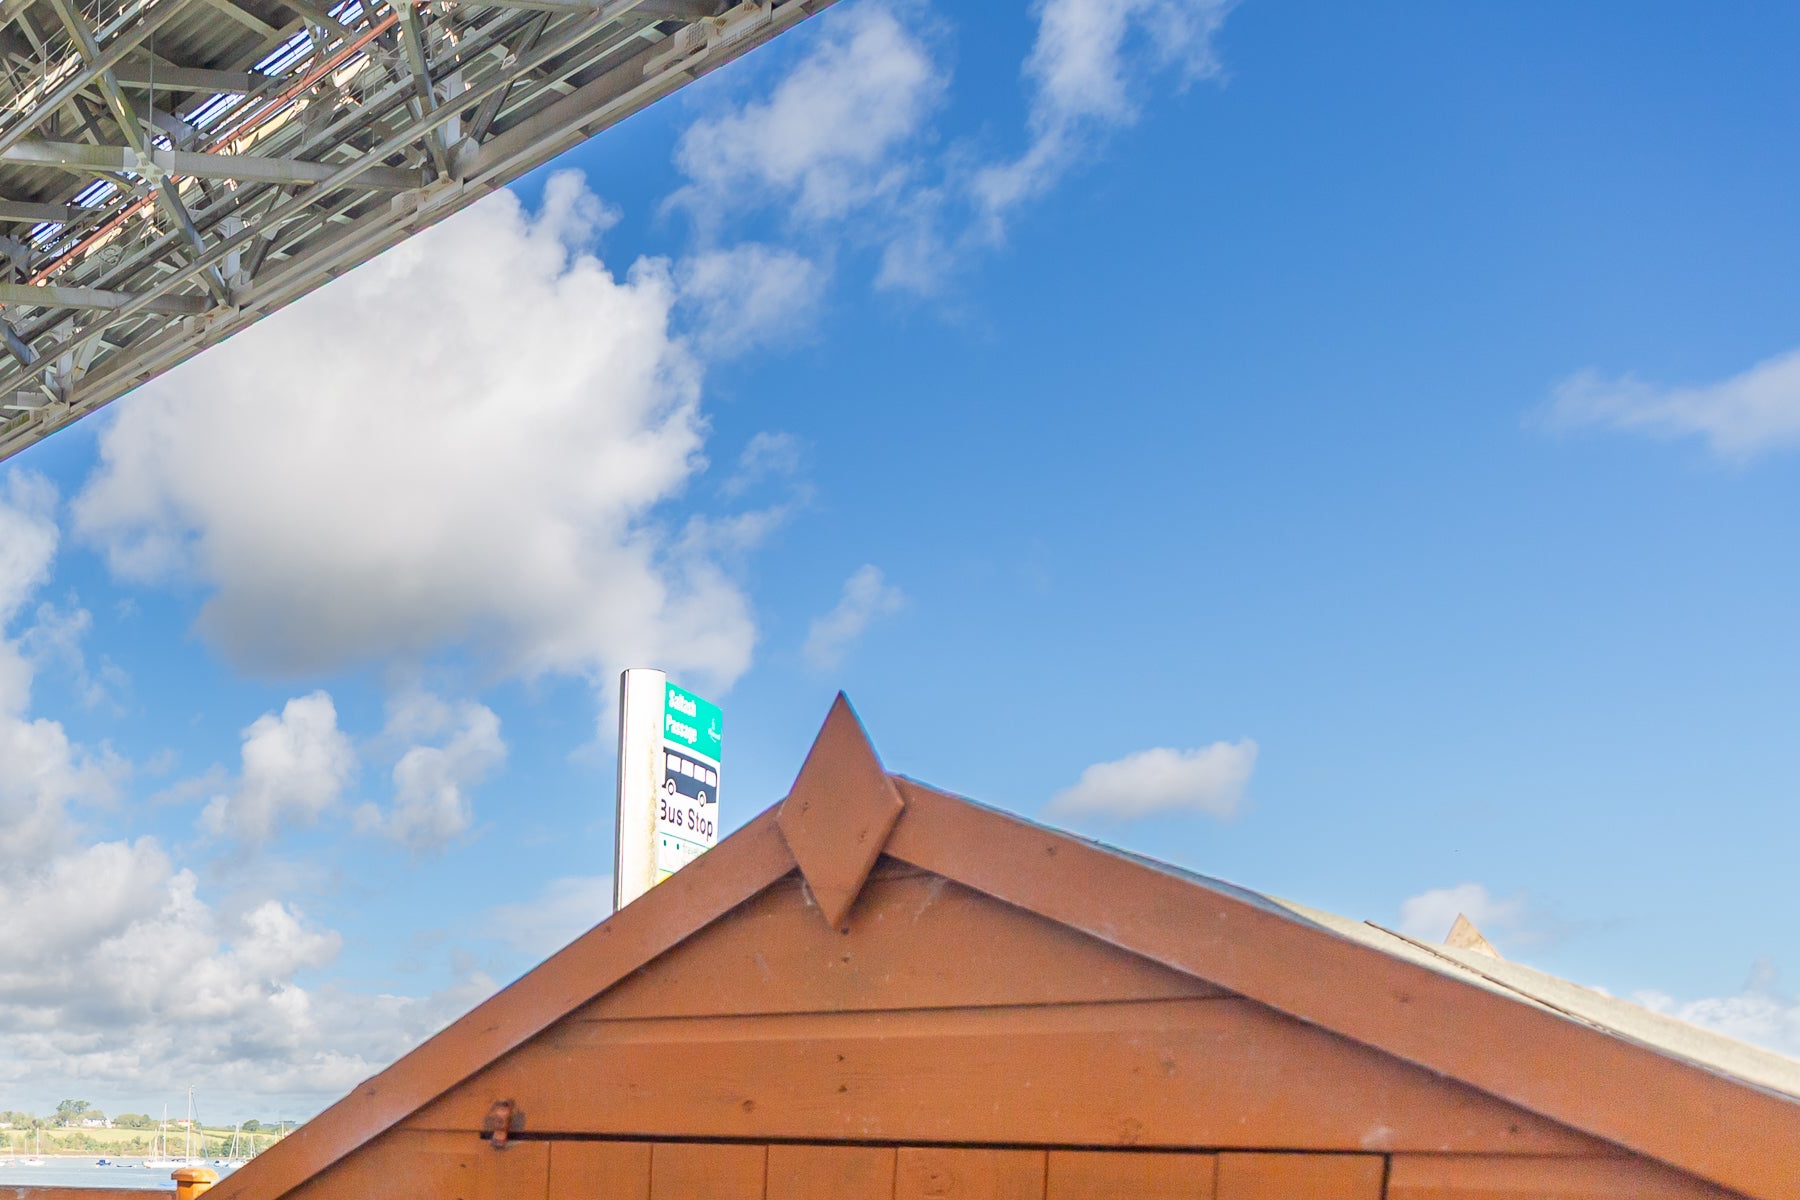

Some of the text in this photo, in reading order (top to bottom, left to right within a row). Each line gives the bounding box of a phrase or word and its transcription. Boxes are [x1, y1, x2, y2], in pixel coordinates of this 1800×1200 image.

[665, 713, 698, 745] Passage
[660, 798, 713, 842] Bus Stop
